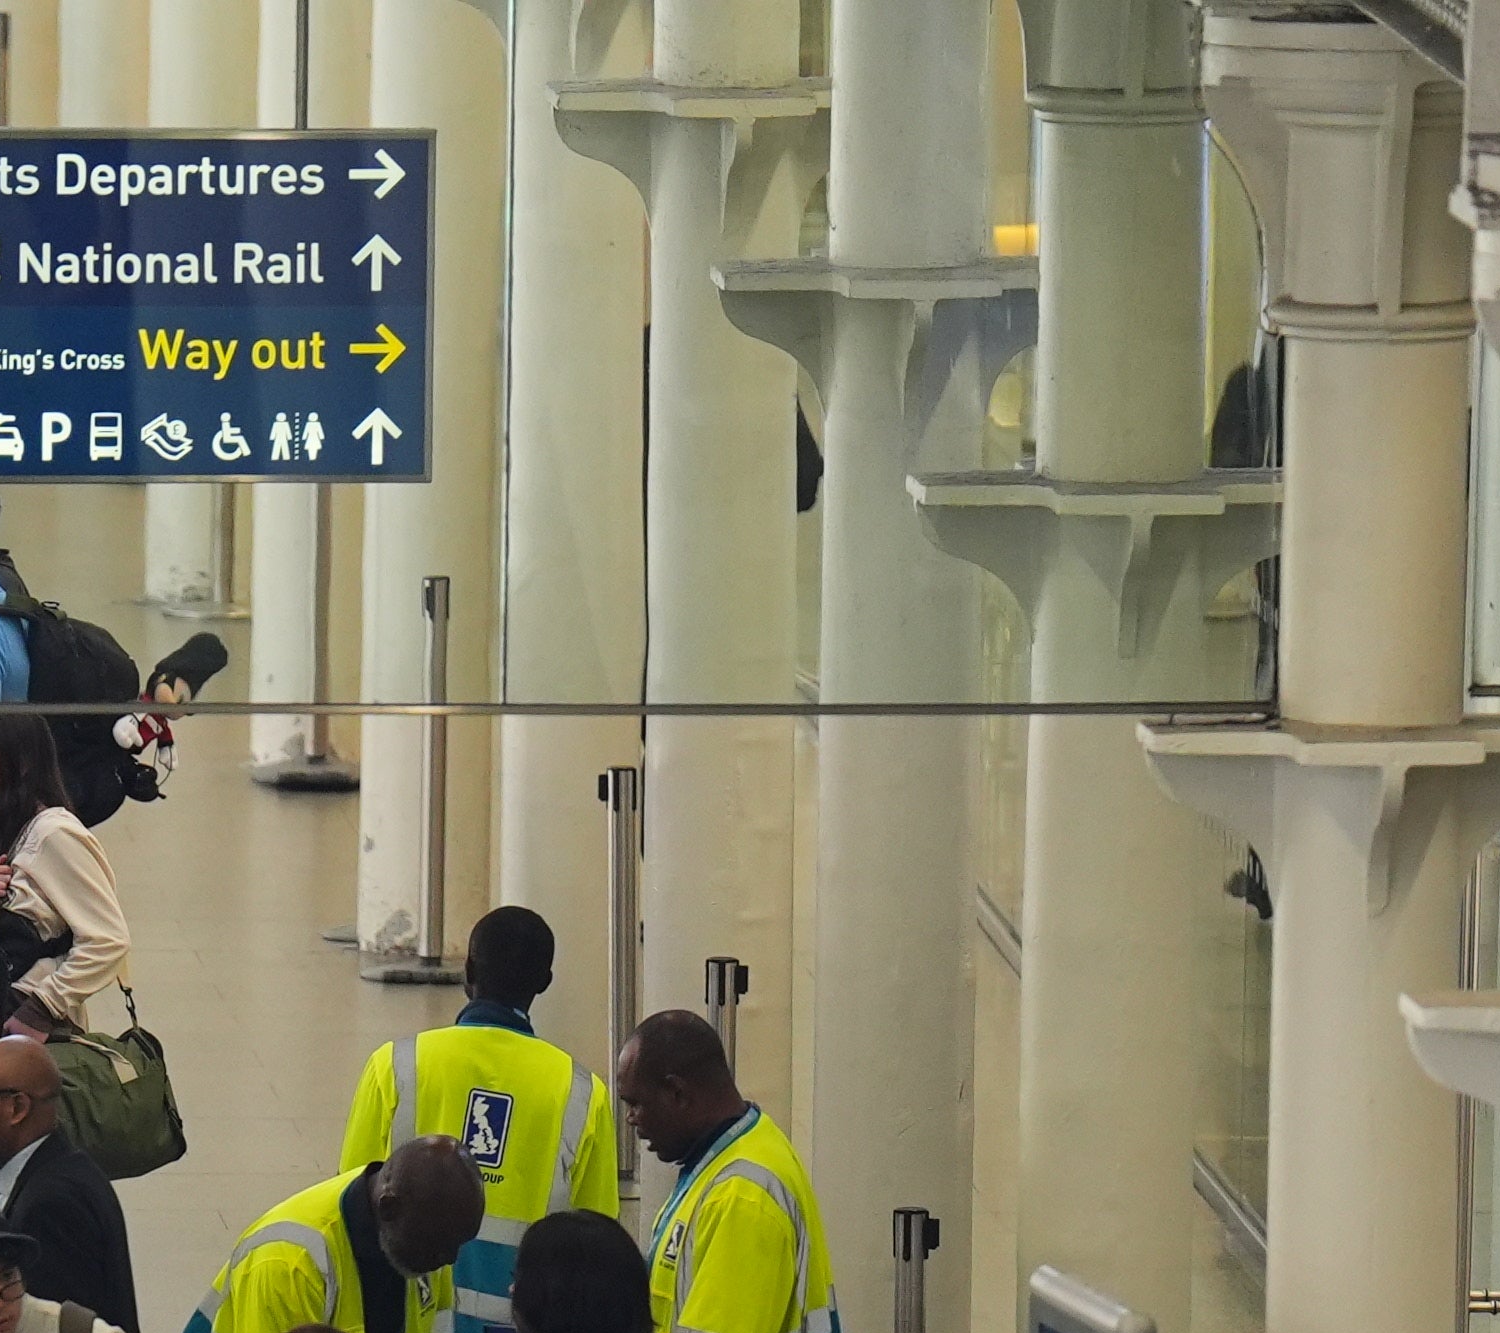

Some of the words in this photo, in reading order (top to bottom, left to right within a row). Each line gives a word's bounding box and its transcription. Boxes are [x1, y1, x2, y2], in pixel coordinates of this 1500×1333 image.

[56, 152, 325, 207] Departures
[18, 241, 218, 284] National
[233, 241, 324, 284] Rail
[60, 348, 126, 371] Cross
[137, 327, 239, 381] Way
[250, 331, 326, 370] out
[480, 1171, 505, 1185] OUP
